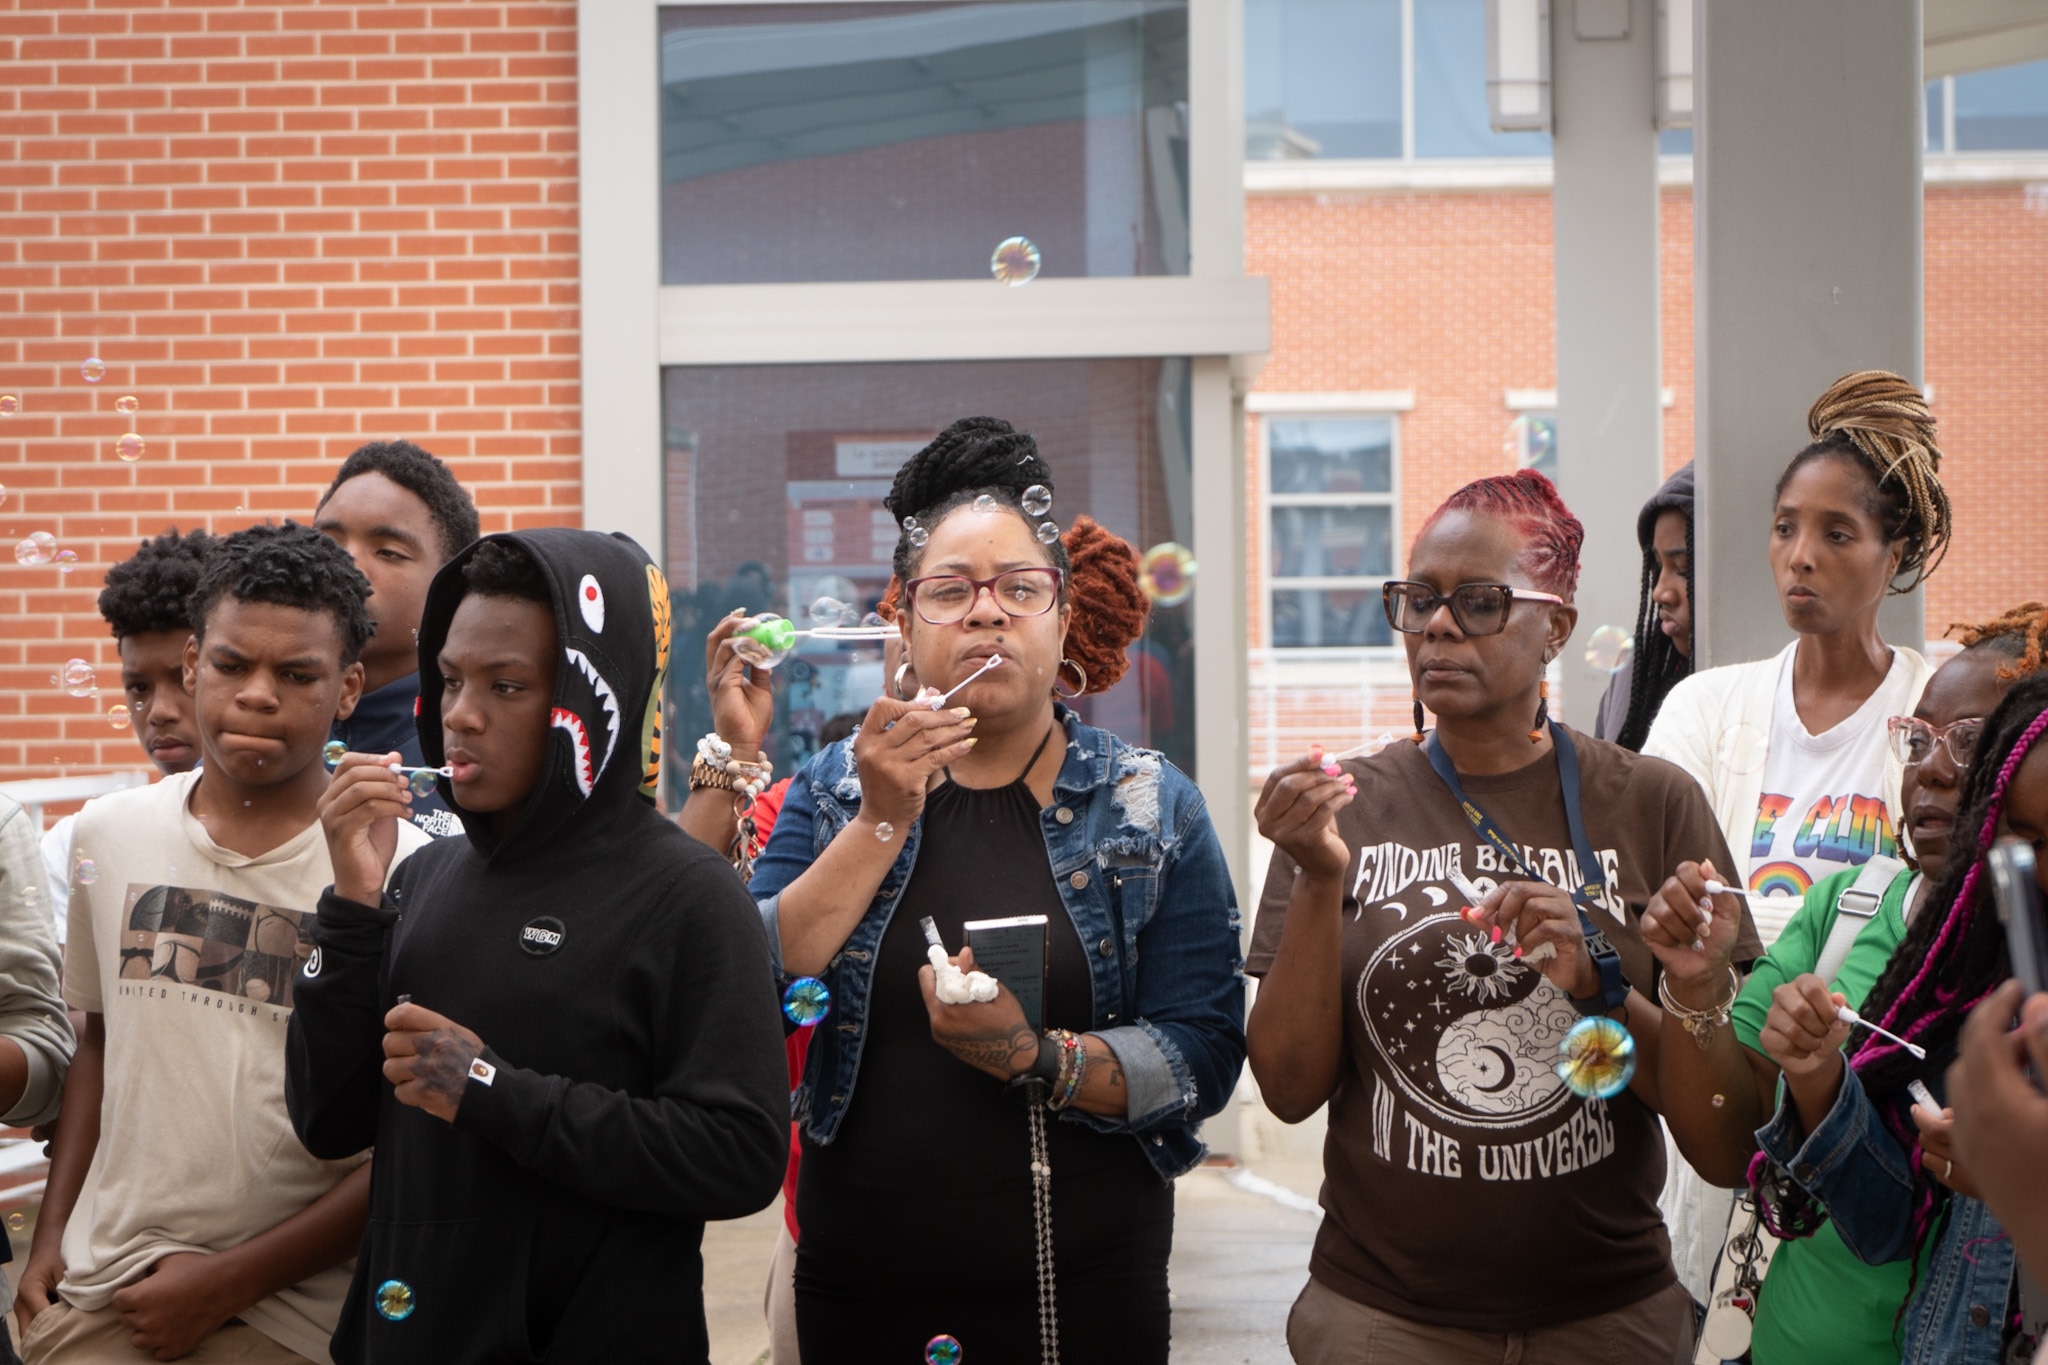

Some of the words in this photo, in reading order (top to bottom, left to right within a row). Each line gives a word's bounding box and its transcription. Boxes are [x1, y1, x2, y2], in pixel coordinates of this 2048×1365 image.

[414, 813, 450, 830] NORTH
[433, 808, 453, 821] THE
[422, 823, 449, 837] FACE
[1352, 841, 1463, 922] FINDING
[1372, 1067, 1396, 1162] IN
[1404, 1110, 1463, 1179] THE
[1477, 1094, 1616, 1181] UNIVERSE
